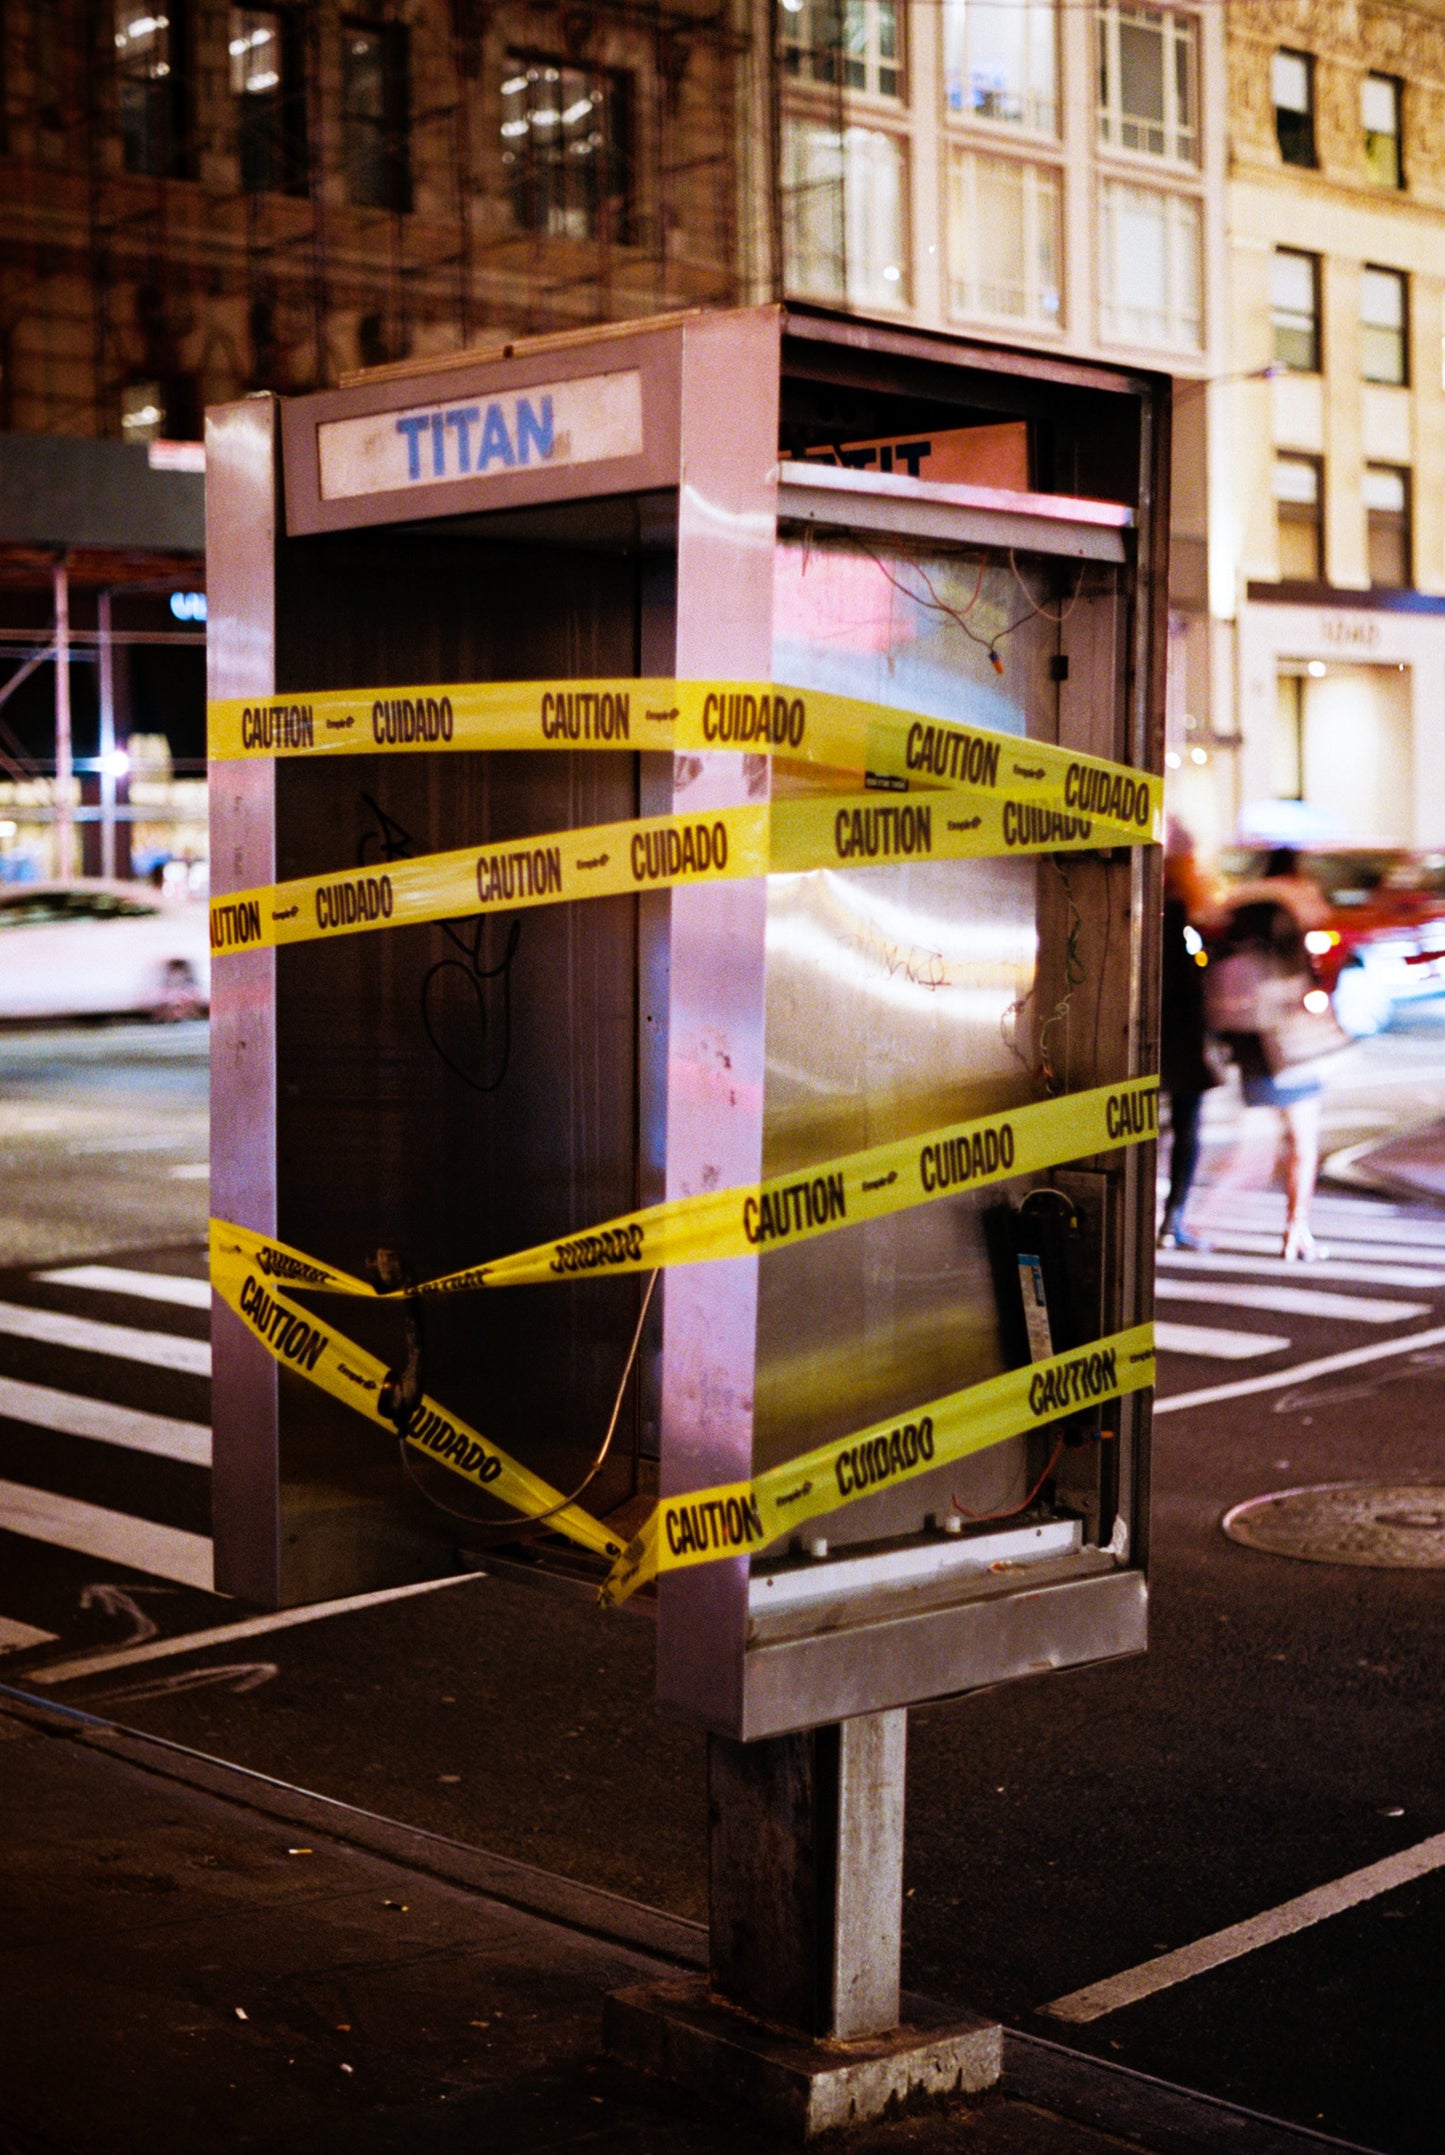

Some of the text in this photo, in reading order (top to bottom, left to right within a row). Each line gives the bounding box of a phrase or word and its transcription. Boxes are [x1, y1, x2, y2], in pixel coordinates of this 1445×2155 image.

[396, 394, 555, 482] TITAN
[242, 705, 314, 750] CAUTION
[372, 696, 454, 745] CUIDADO
[541, 692, 630, 741] CAUTION
[702, 693, 806, 748] CUIDADO
[906, 722, 1000, 788] CAUTION
[1063, 763, 1150, 827] CUIDADO
[315, 875, 394, 930] CUIDADO
[476, 847, 562, 902] CAUTION
[631, 821, 727, 881] CUIDADO
[835, 806, 932, 859] CAUTION
[1003, 801, 1092, 846] CUIDADO
[743, 1172, 847, 1244] CAUTION
[920, 1123, 1014, 1193] CUIDADO
[239, 1275, 329, 1372] CAUTION
[408, 1404, 503, 1484] UIDADO
[665, 1493, 763, 1556] CAUTION
[835, 1416, 935, 1497] CUIDADO
[1027, 1347, 1118, 1417] CAUTION
